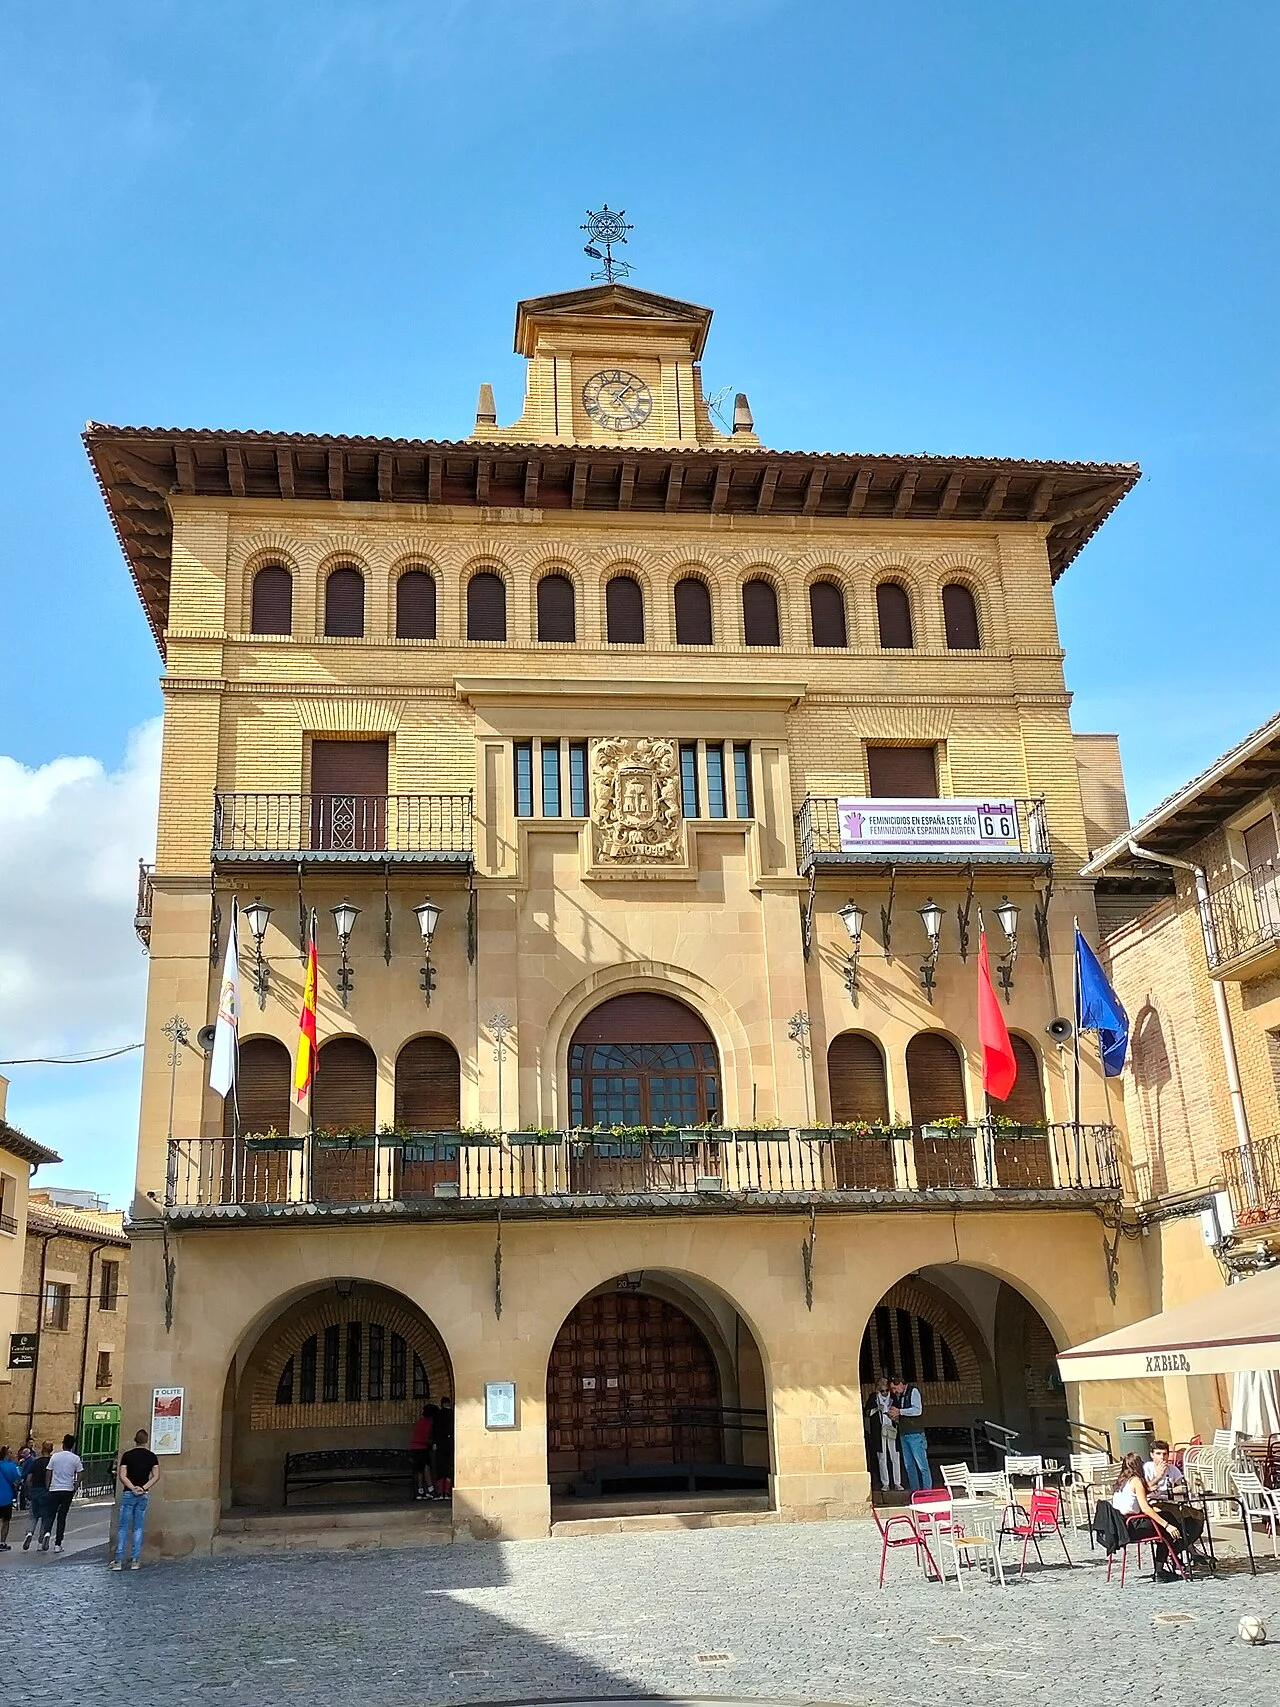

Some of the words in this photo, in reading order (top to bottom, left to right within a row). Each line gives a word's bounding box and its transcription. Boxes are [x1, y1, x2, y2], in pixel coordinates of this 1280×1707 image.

[869, 816, 911, 825] FEMINICIDIOS
[911, 816, 920, 825] EN
[921, 815, 945, 825] ESPAÑA
[947, 816, 962, 825] ESTE
[963, 815, 977, 825] AÑO
[917, 826, 949, 835] ESPAINIAN
[951, 826, 976, 835] AURTEN
[617, 1280, 627, 1288] 20
